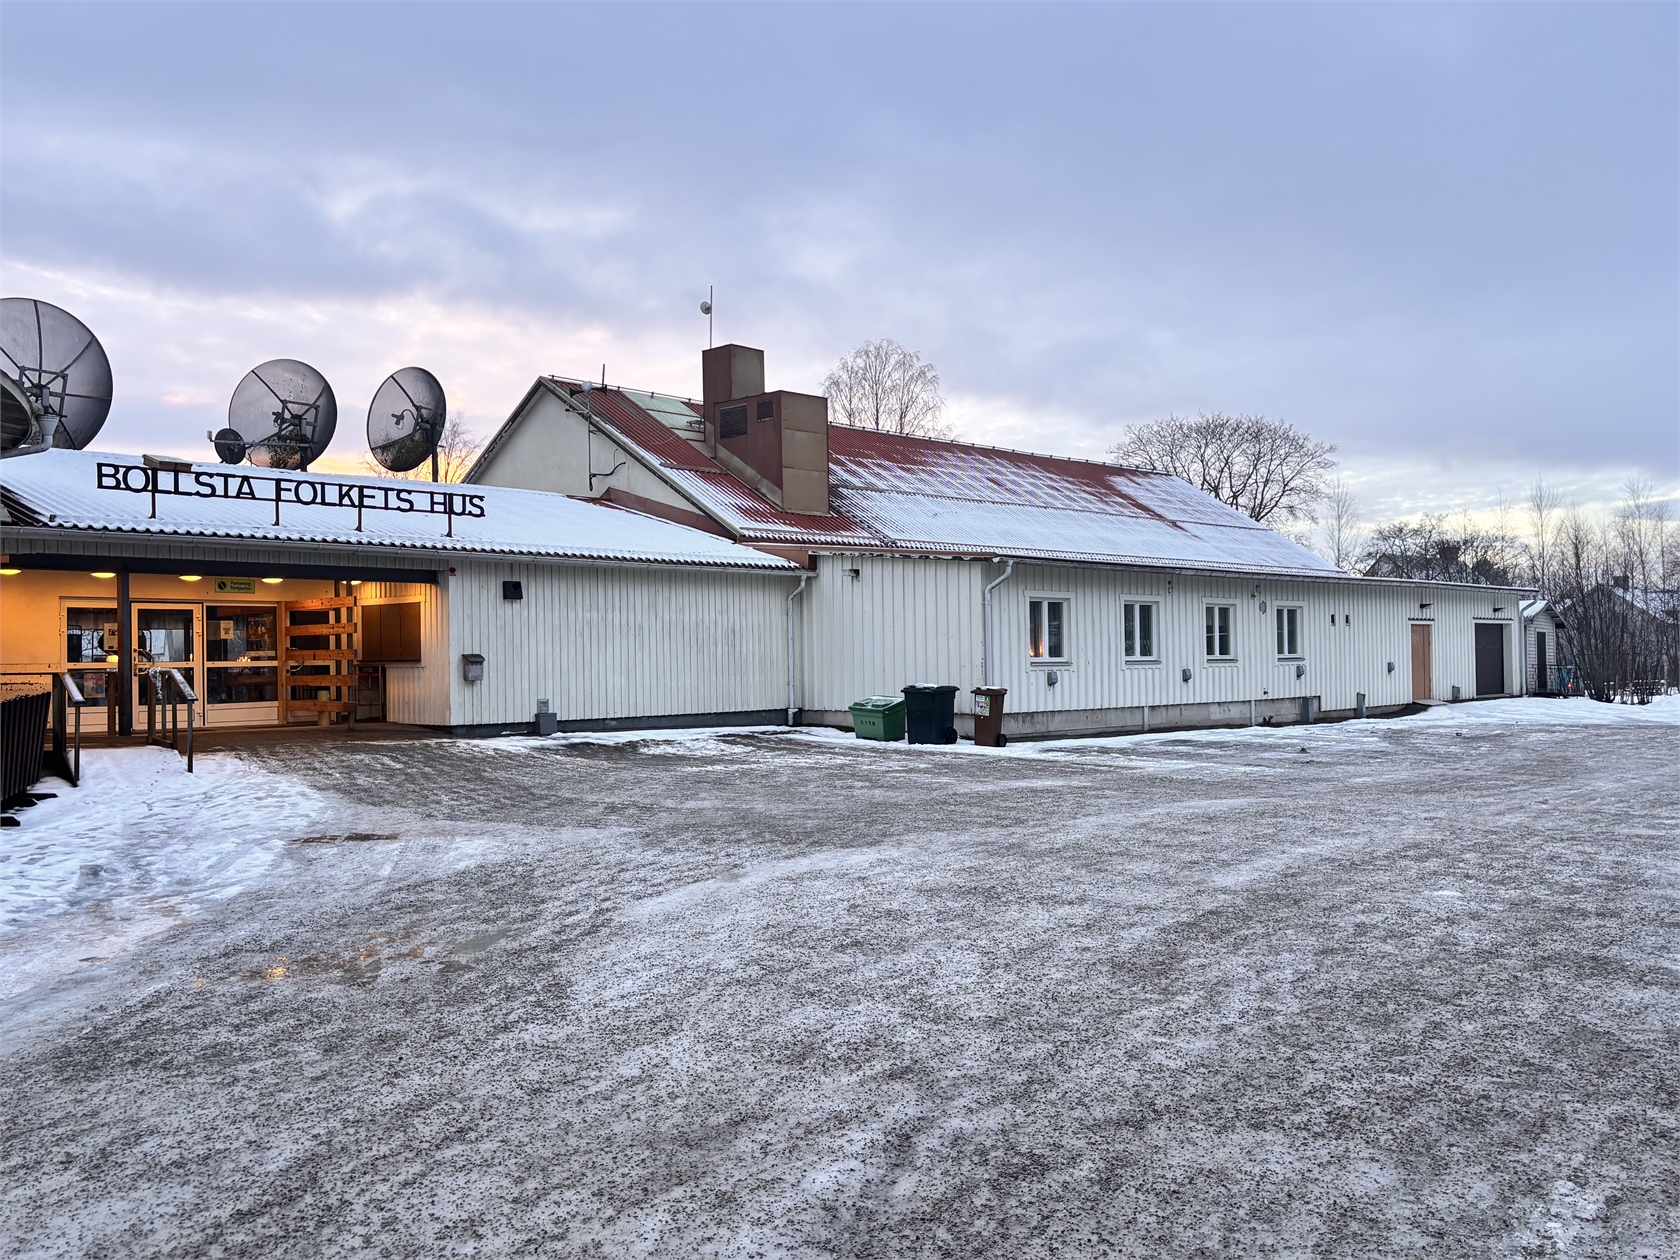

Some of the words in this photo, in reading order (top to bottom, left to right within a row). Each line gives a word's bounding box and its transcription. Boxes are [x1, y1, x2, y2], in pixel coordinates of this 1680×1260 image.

[97, 462, 256, 498] BOLLSTA
[275, 478, 415, 512] FOLKETS
[430, 491, 486, 518] HUS
